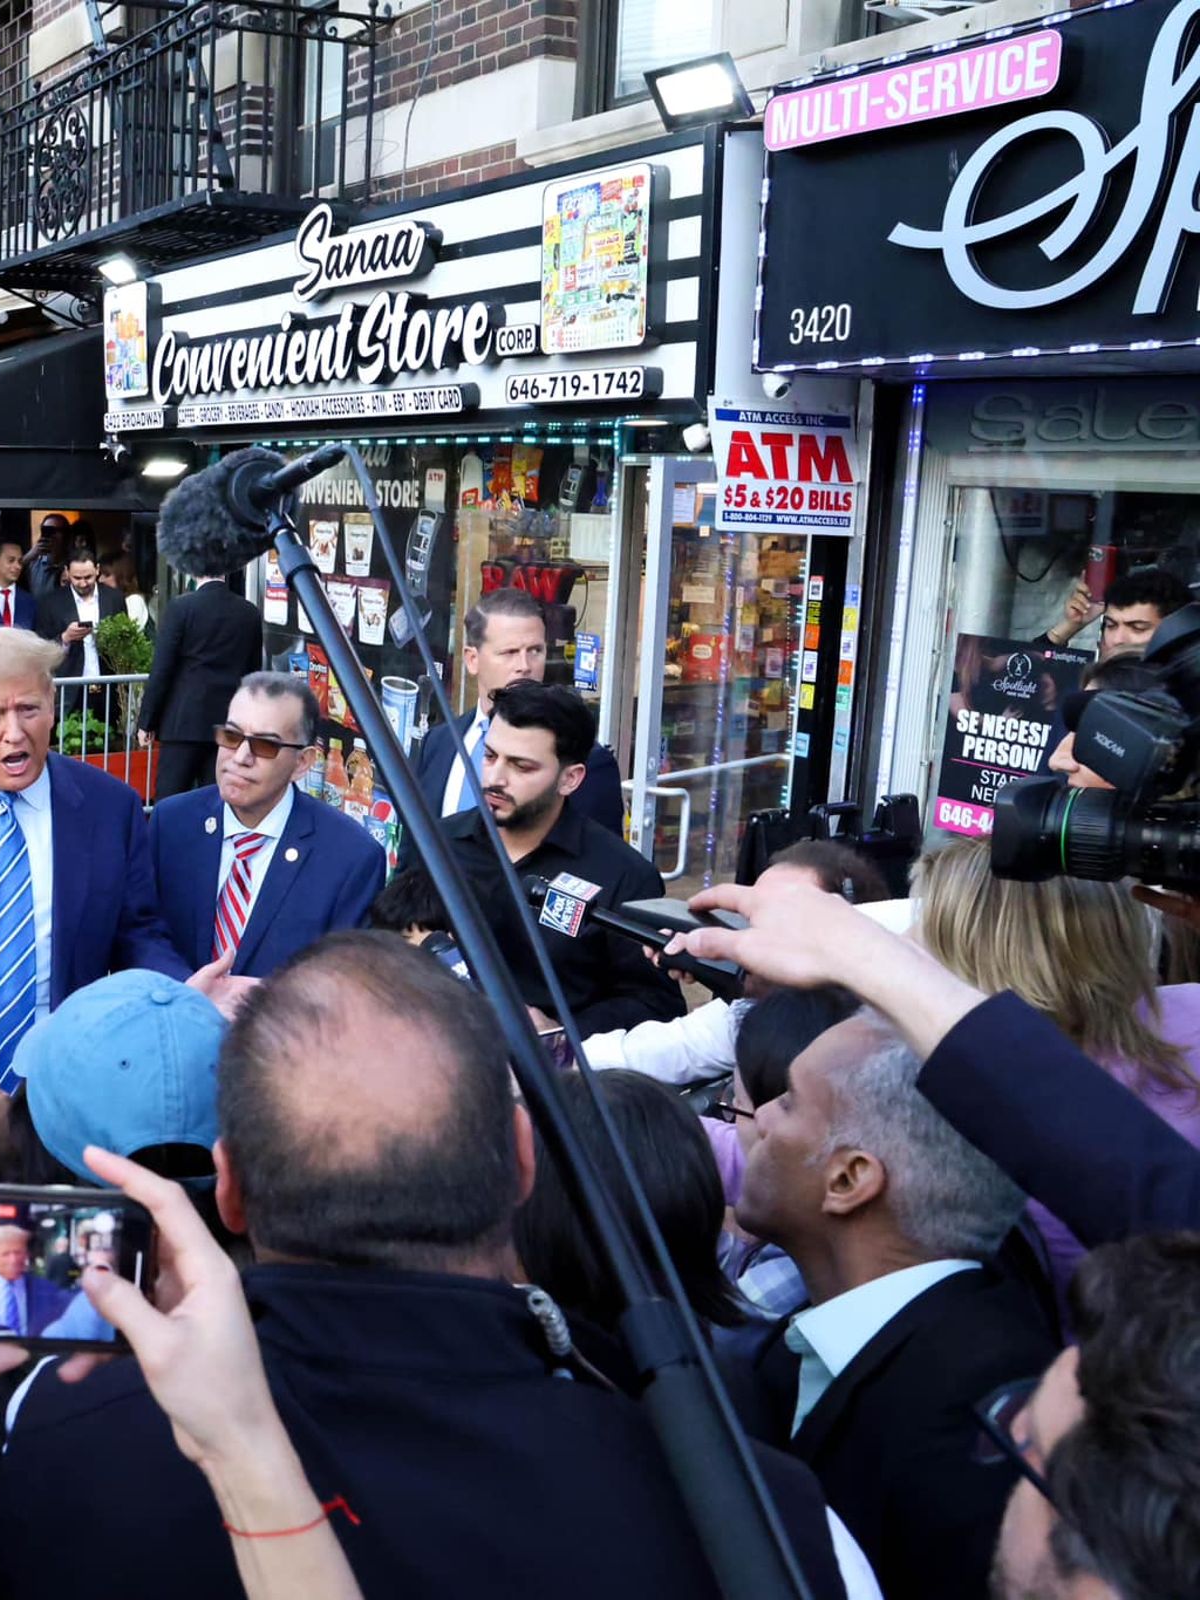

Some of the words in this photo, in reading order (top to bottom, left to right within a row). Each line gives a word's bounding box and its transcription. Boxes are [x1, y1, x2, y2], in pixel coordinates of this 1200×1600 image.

[770, 36, 1053, 145] MULTI-SERVICE
[298, 211, 415, 296] Sanaa
[499, 327, 533, 351] CORP.
[789, 303, 852, 345] 3420
[152, 301, 353, 404] Convenient
[356, 292, 494, 384] Store
[509, 370, 641, 400] 646-719-1742
[122, 410, 163, 427] BROADWAY
[291, 398, 321, 418] HOOKAH
[322, 395, 365, 416] ACCESSORIES
[371, 393, 387, 414] ATM
[394, 392, 407, 412] EBT
[413, 389, 435, 411] DEBIT
[438, 388, 461, 409] CARD
[738, 411, 763, 424] ATM
[765, 414, 803, 425] ACCESS
[805, 416, 825, 427] INC
[726, 430, 853, 483] ATM
[375, 480, 419, 508] STORE
[724, 484, 747, 508] $5
[750, 491, 761, 509] &
[765, 485, 804, 511] $20
[808, 490, 852, 513] BILLS
[956, 708, 980, 734] SE
[981, 713, 1052, 748] NECESI
[939, 802, 995, 834] 646-4
